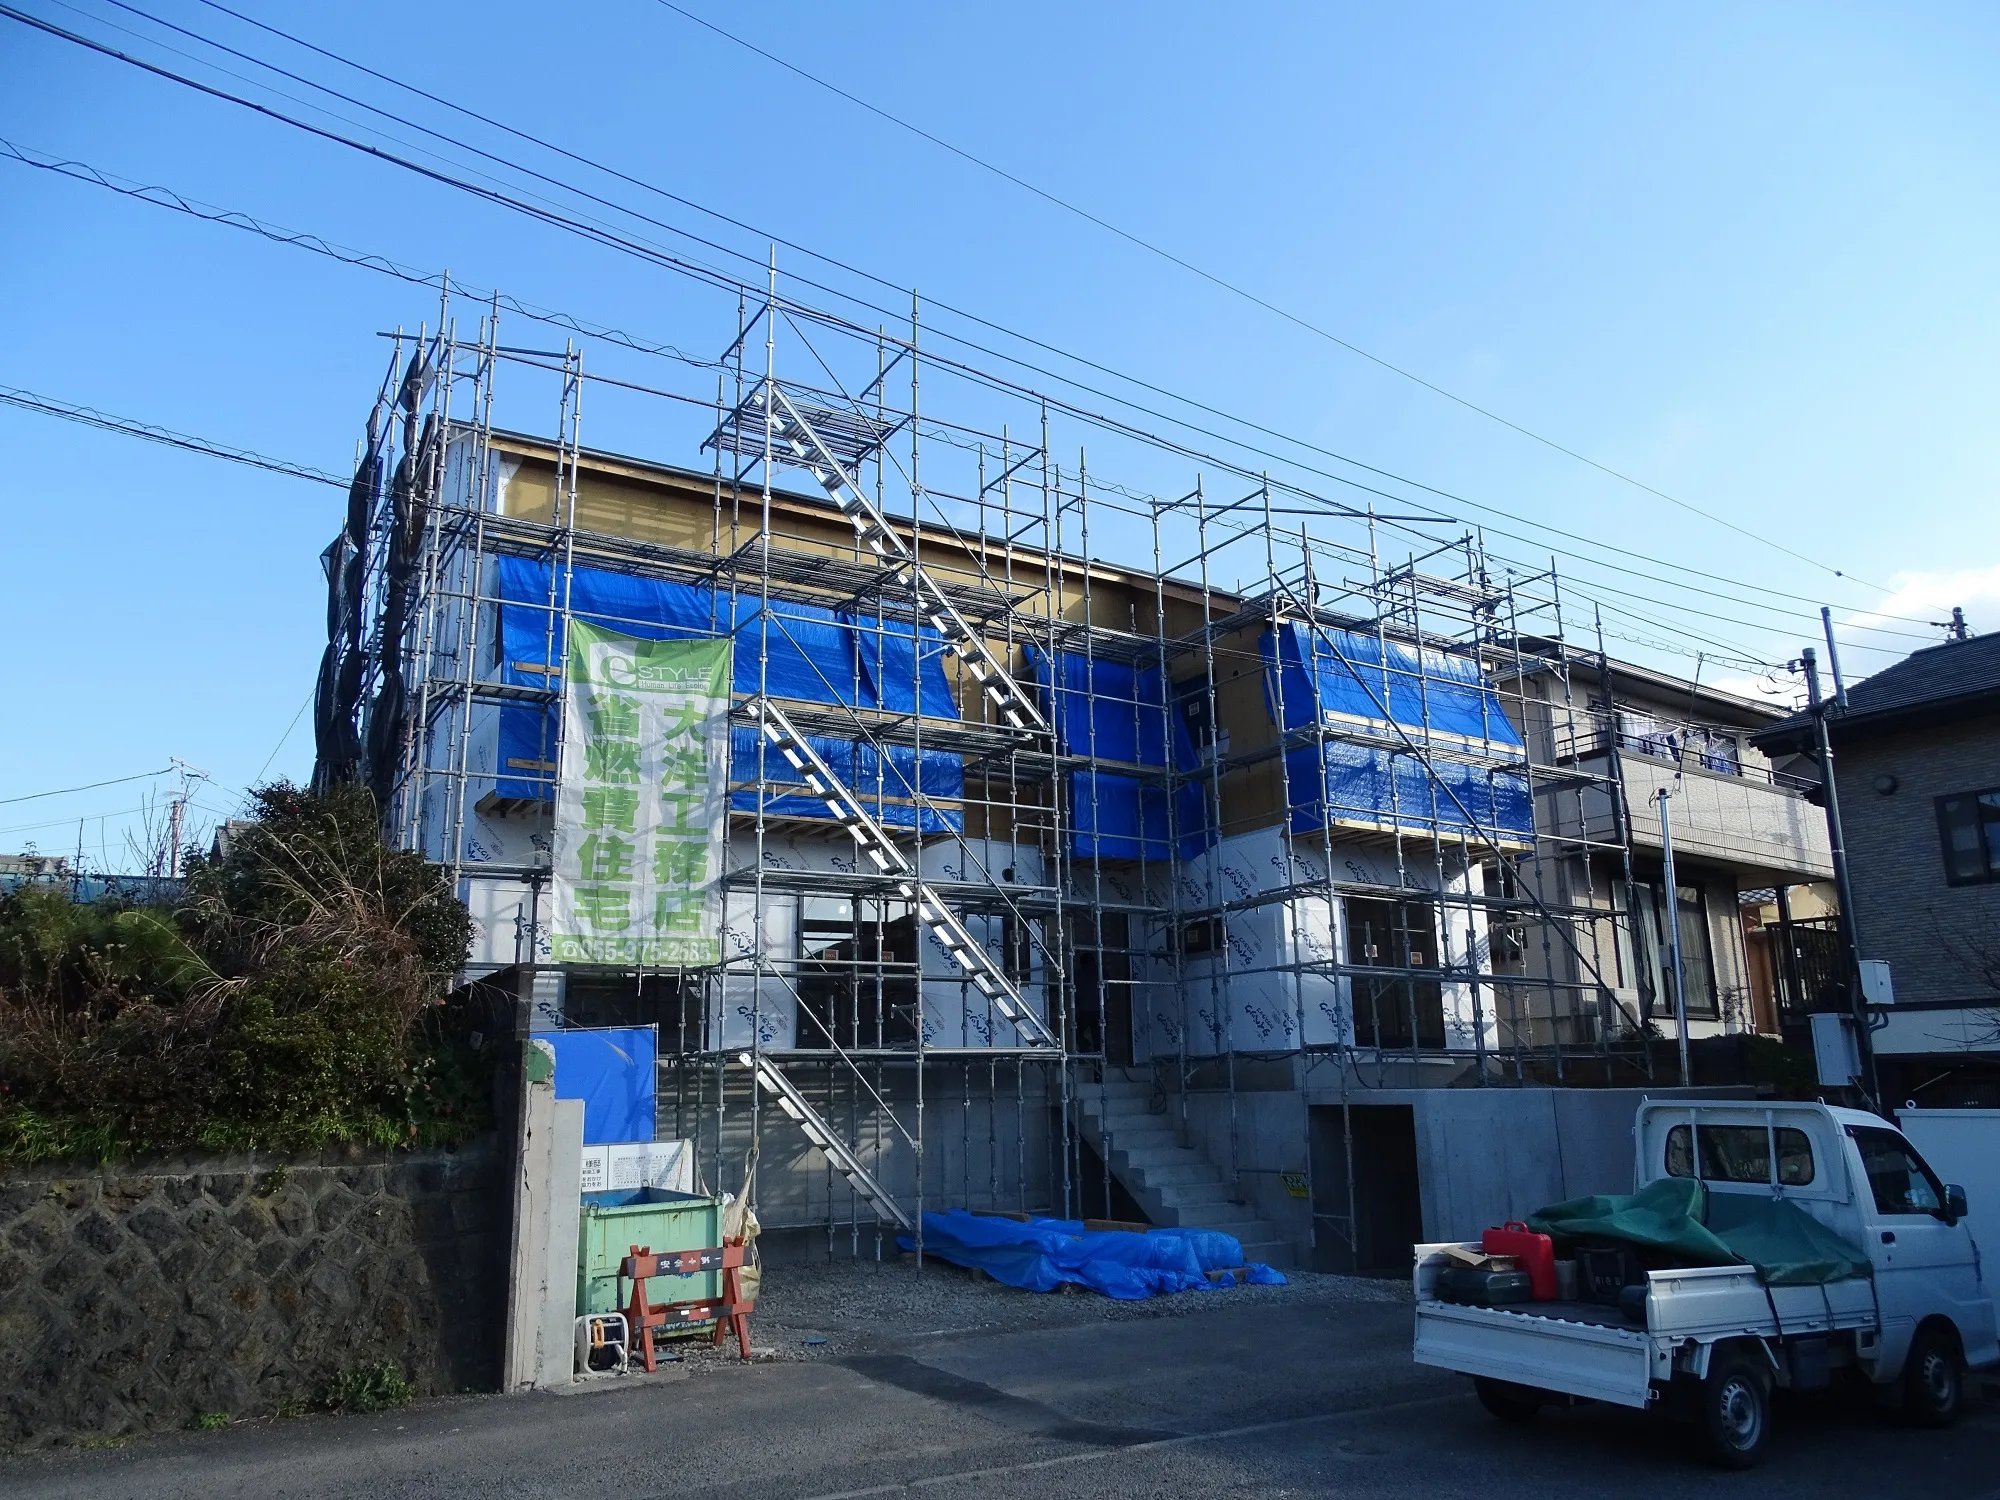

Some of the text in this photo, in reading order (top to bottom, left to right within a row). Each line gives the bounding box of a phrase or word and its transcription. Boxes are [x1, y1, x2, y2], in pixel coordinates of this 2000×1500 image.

[638, 665, 713, 681] STYLE
[641, 681, 665, 689] Human
[668, 682, 682, 690] Life
[573, 692, 642, 931] 省燃費住宅
[652, 700, 709, 932] 大洋工務店
